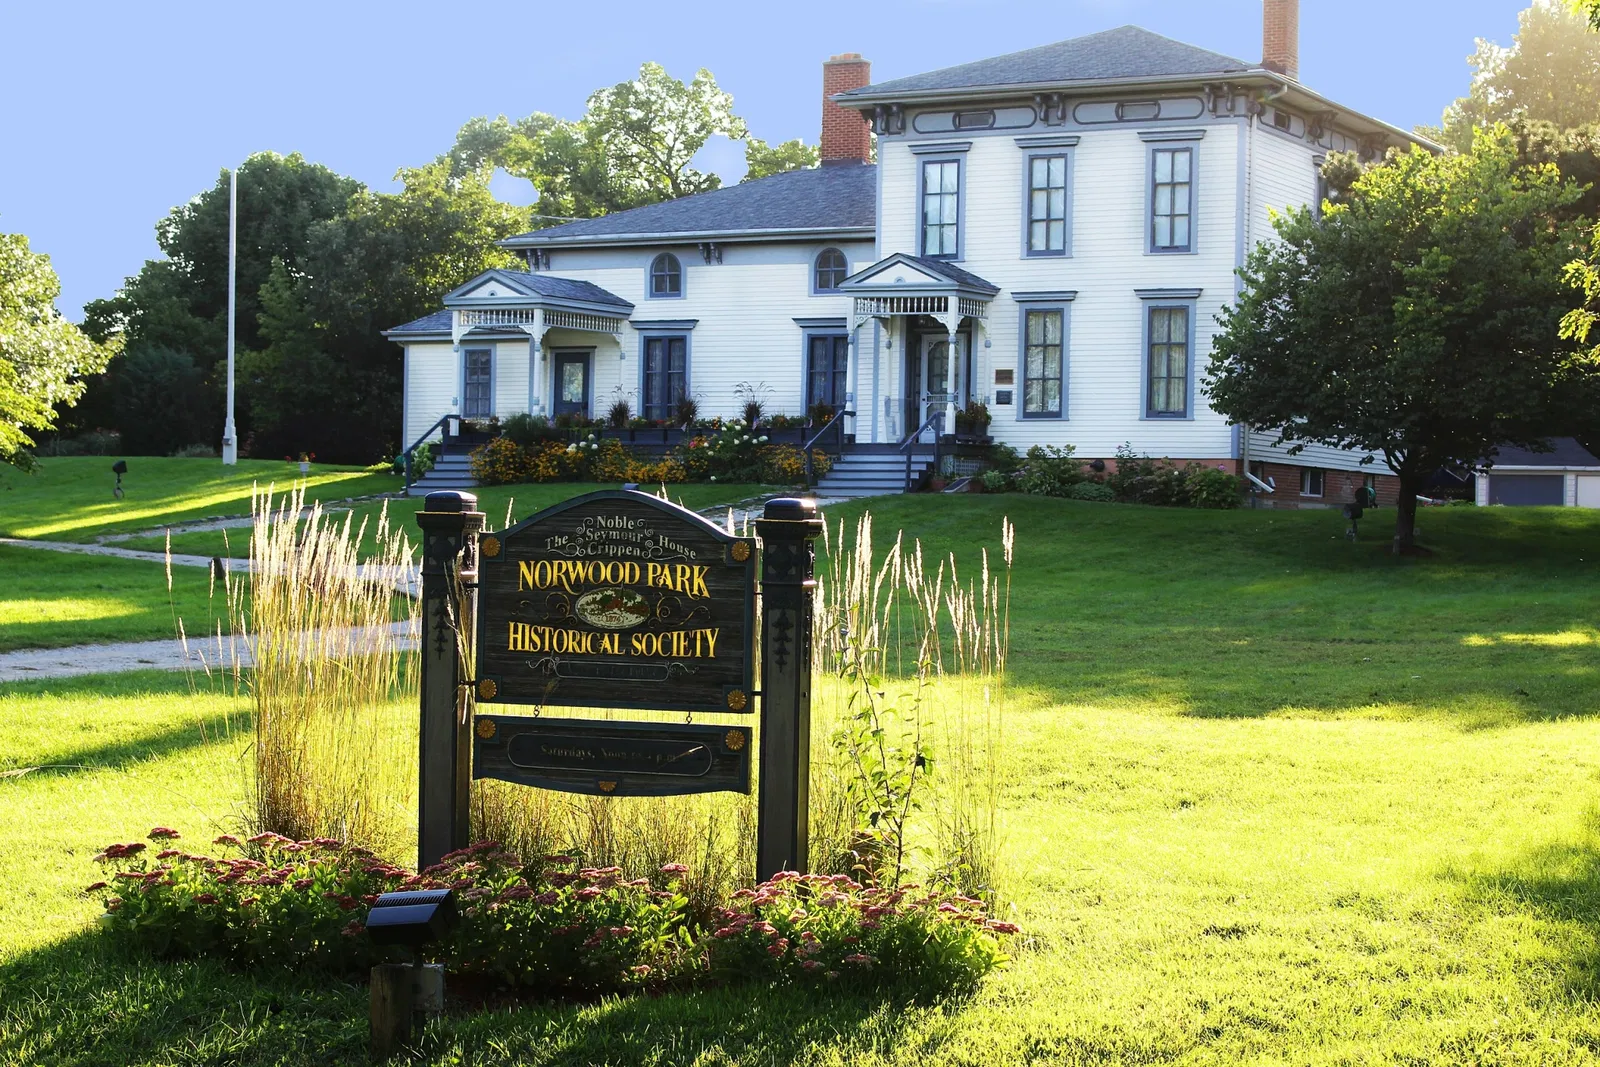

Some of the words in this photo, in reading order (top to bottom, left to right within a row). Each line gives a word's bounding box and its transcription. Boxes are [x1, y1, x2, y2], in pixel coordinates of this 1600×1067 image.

[596, 515, 634, 530] Noble
[545, 533, 569, 550] The
[585, 527, 644, 543] Seymour
[587, 542, 641, 556] Crippen
[659, 534, 697, 560] House
[518, 560, 641, 595] NORWOOD
[646, 562, 711, 600] PARK
[508, 621, 626, 656] HISTORICAL
[631, 628, 720, 658] SOCIETY
